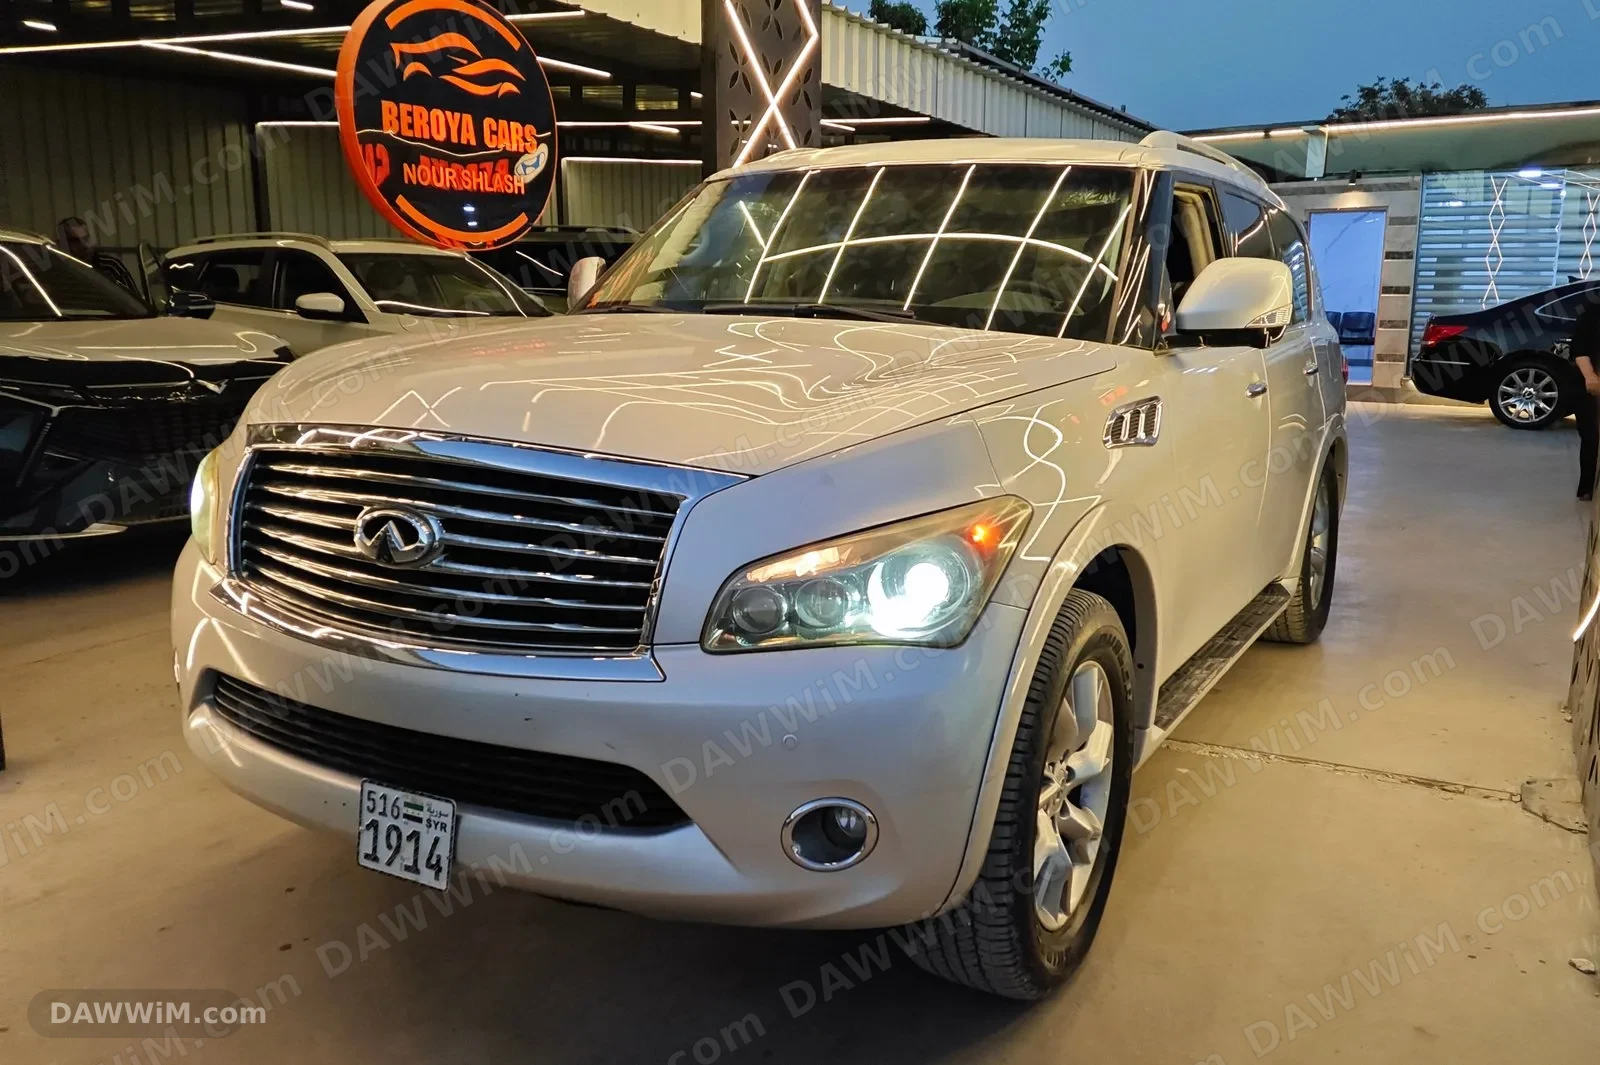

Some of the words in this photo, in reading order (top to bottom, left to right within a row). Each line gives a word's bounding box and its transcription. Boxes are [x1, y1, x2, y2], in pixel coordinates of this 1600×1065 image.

[381, 100, 476, 146] BEROYA
[483, 117, 537, 154] CARS
[403, 162, 457, 188] NOUR
[461, 169, 525, 195] SHLASH
[366, 789, 400, 820] 516
[426, 802, 450, 818] سورية
[425, 818, 448, 833] SYR
[363, 818, 443, 881] 1914
